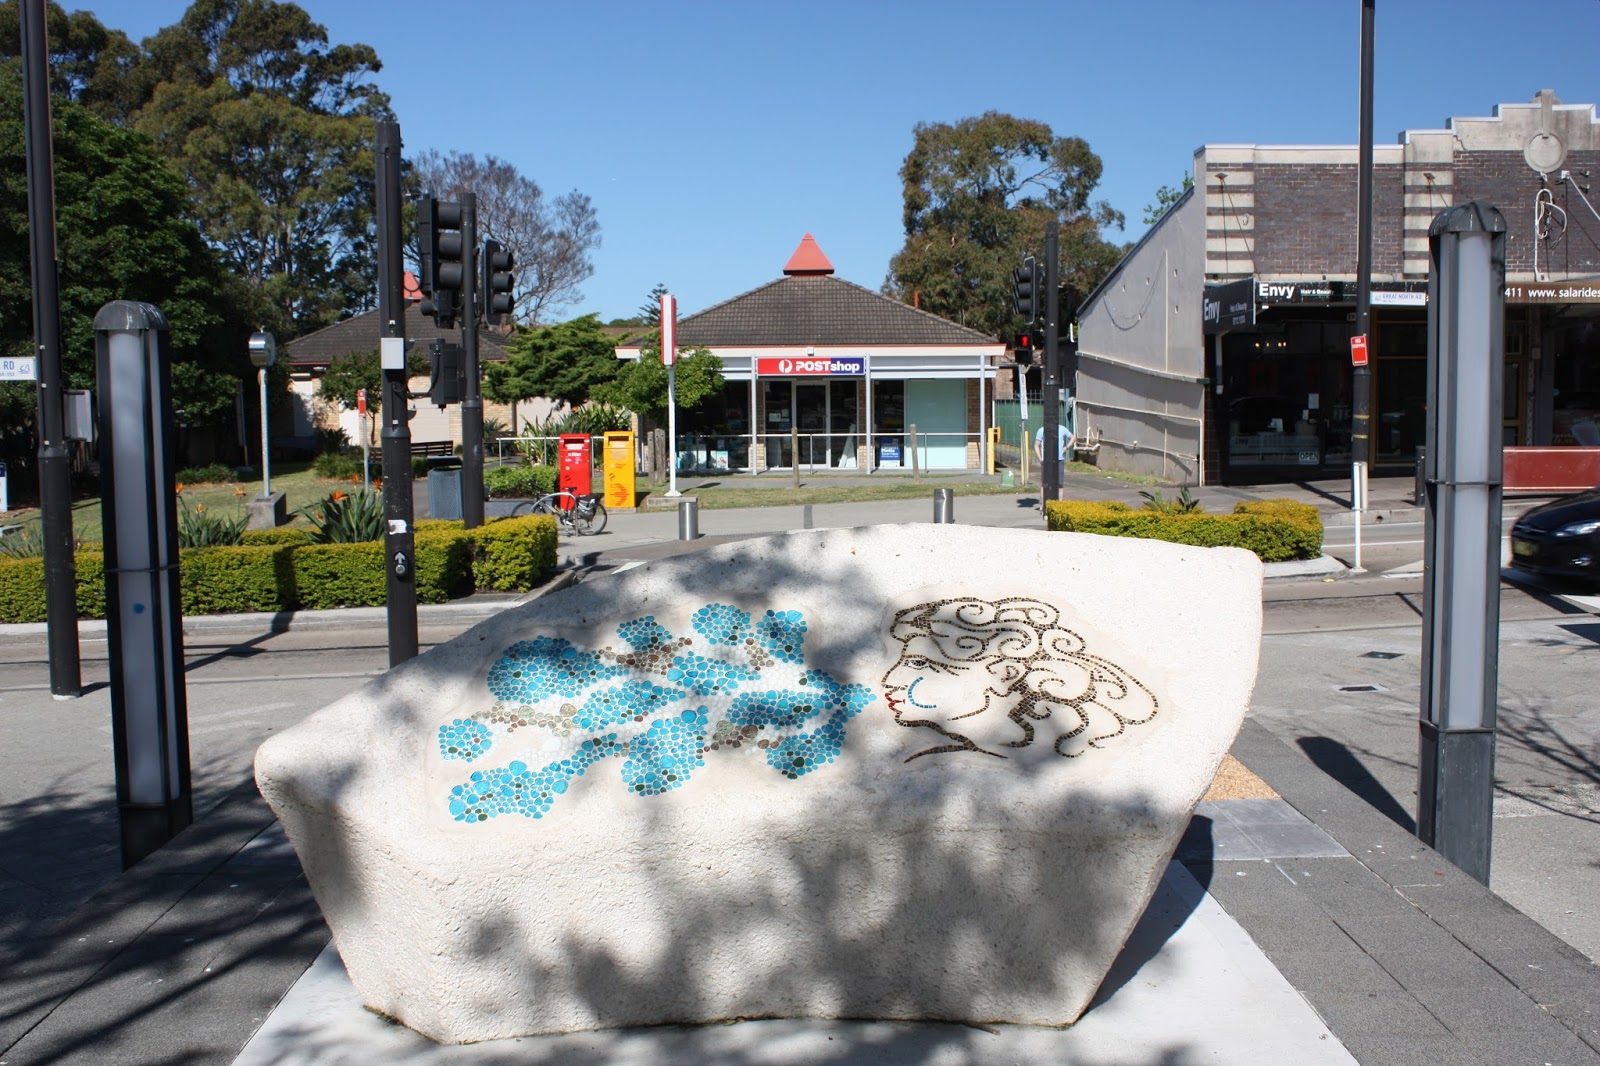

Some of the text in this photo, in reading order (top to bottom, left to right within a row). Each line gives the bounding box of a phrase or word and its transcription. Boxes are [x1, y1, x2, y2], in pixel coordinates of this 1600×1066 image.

[1259, 283, 1295, 299] Envy
[1528, 289, 1557, 298] www.
[1204, 298, 1221, 324] Envy
[3, 360, 15, 370] RD
[795, 360, 860, 374] POSTshop
[1299, 452, 1319, 461] OPEN
